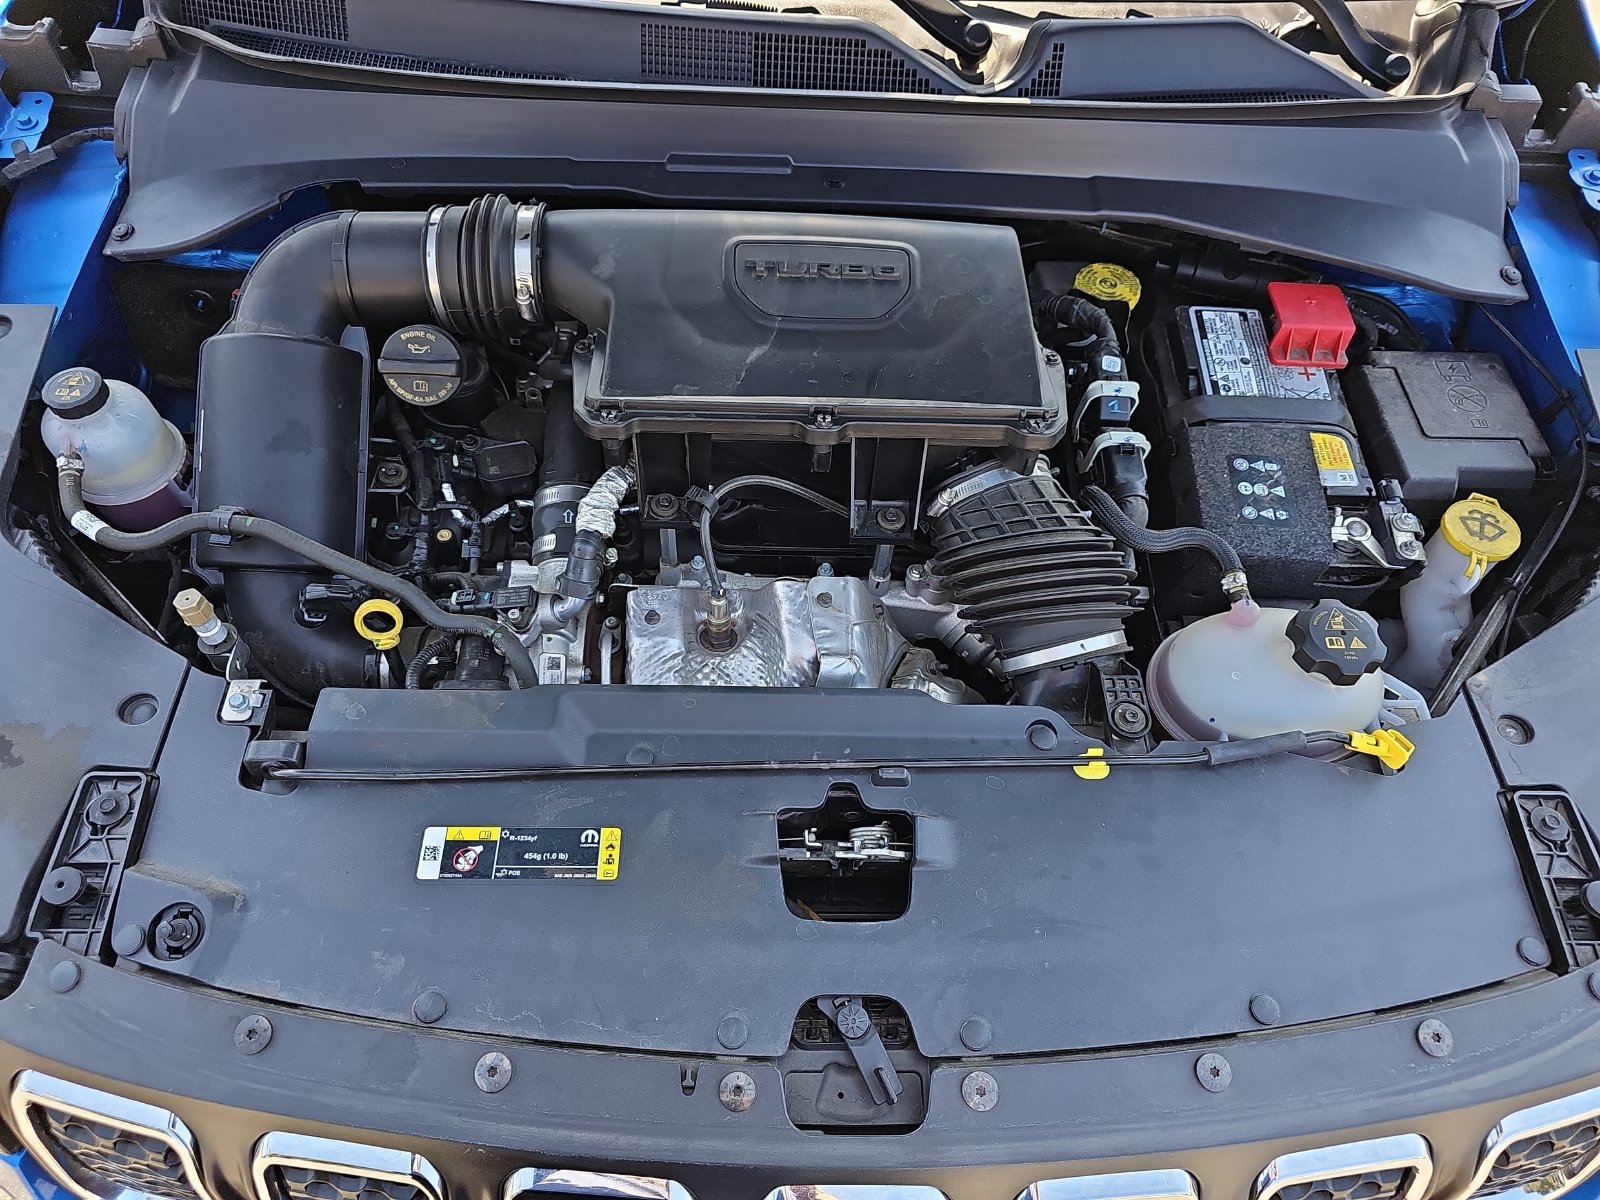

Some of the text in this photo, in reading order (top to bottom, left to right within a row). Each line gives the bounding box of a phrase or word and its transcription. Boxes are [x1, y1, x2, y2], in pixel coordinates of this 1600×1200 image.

[745, 259, 902, 280] TURBO
[400, 330, 437, 343] ENGINE OIL
[388, 378, 398, 389] API
[438, 382, 453, 398] 5W-30
[523, 852, 569, 861] 454g (1.0 lb)
